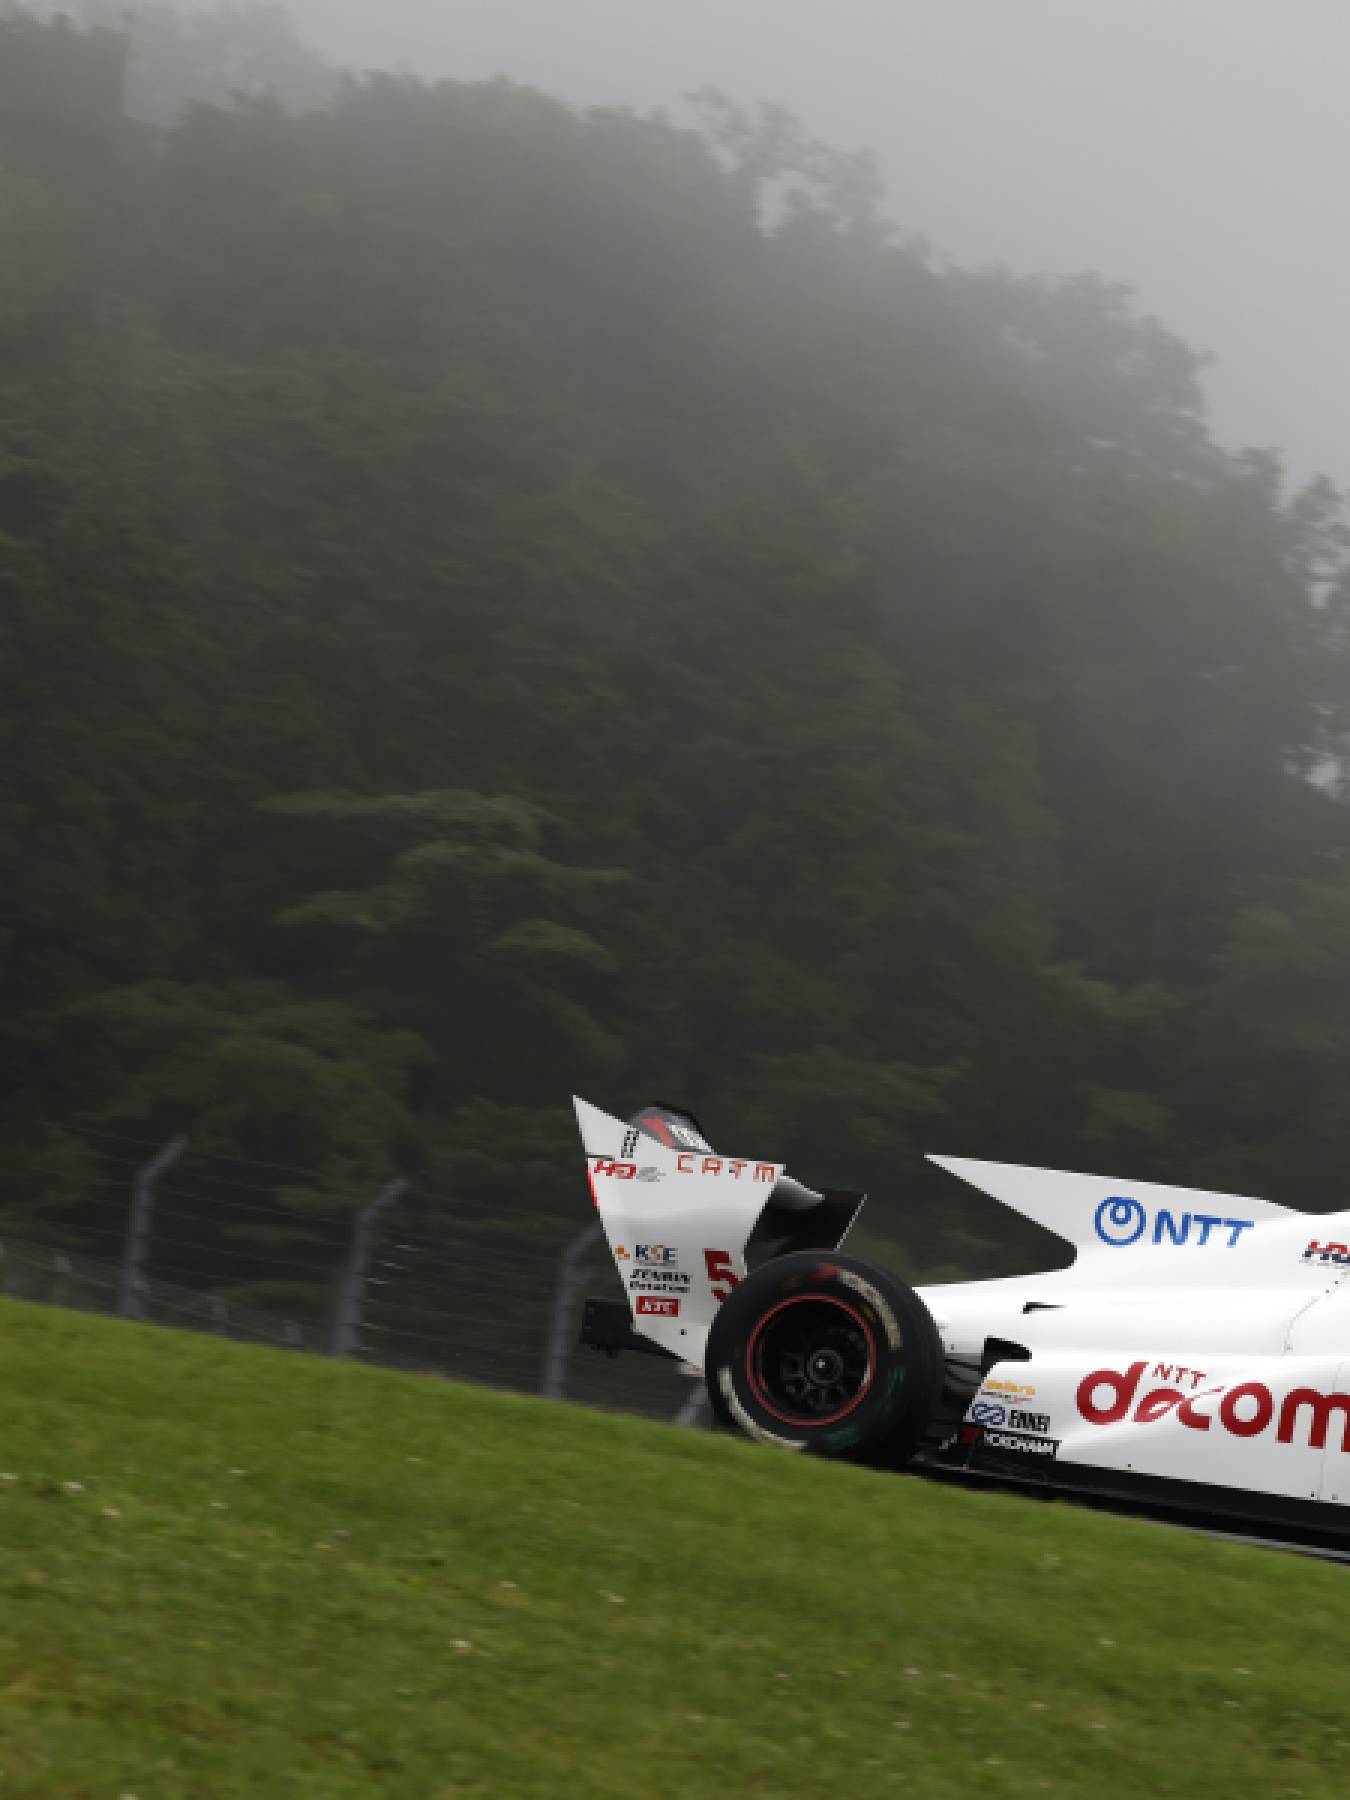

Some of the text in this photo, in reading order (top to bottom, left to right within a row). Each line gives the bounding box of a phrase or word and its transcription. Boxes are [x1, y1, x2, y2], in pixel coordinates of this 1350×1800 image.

[1153, 1210, 1254, 1248] NTT
[704, 1248, 741, 1303] 5
[1153, 1363, 1206, 1388] NTT
